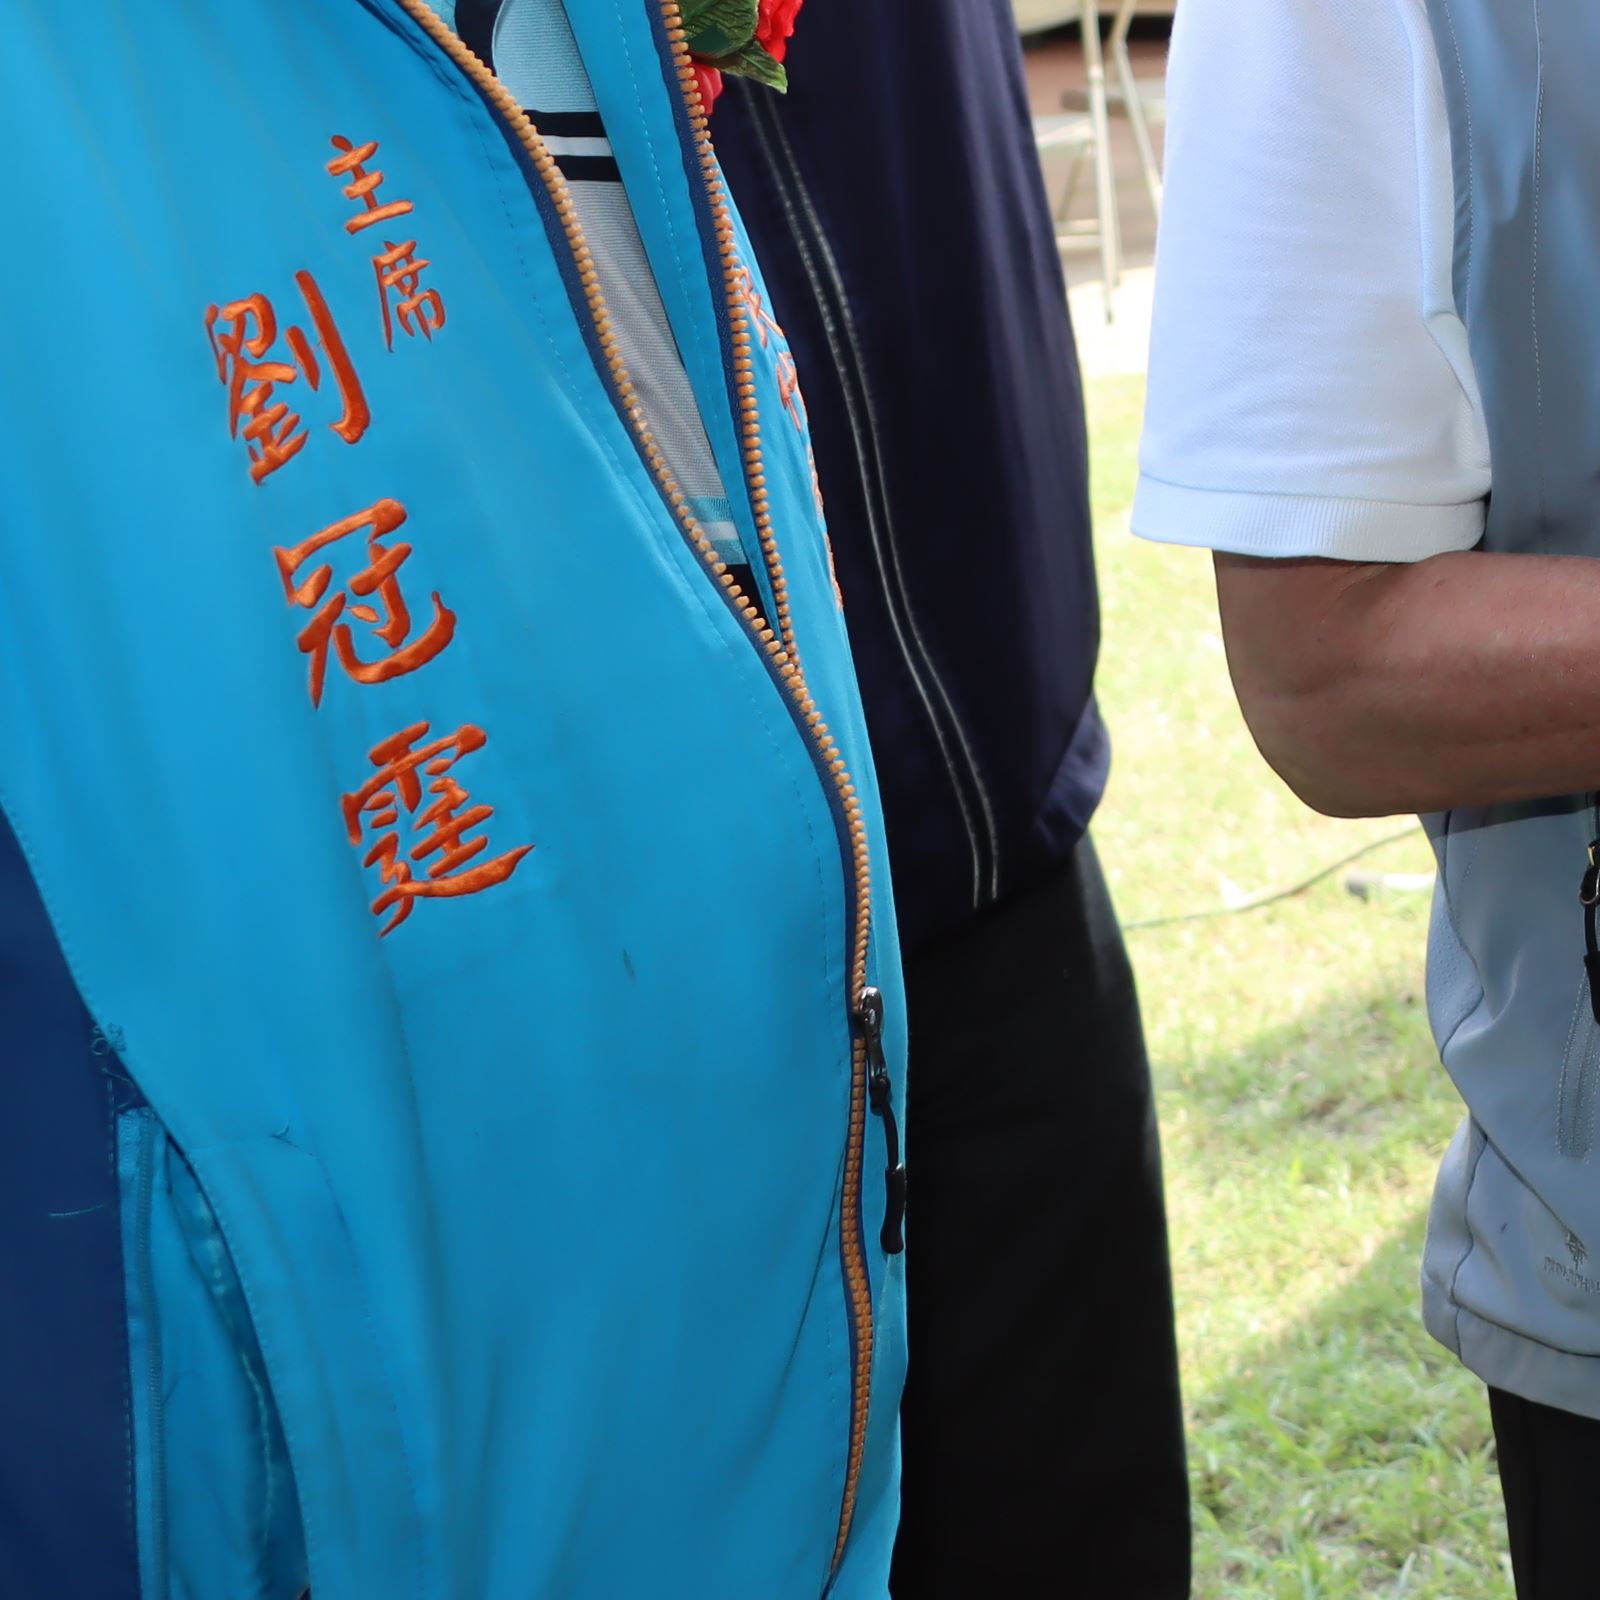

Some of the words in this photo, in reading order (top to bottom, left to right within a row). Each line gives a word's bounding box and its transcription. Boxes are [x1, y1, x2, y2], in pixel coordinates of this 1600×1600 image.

[325, 134, 447, 352] 主席
[204, 269, 537, 939] 劉冠霆
